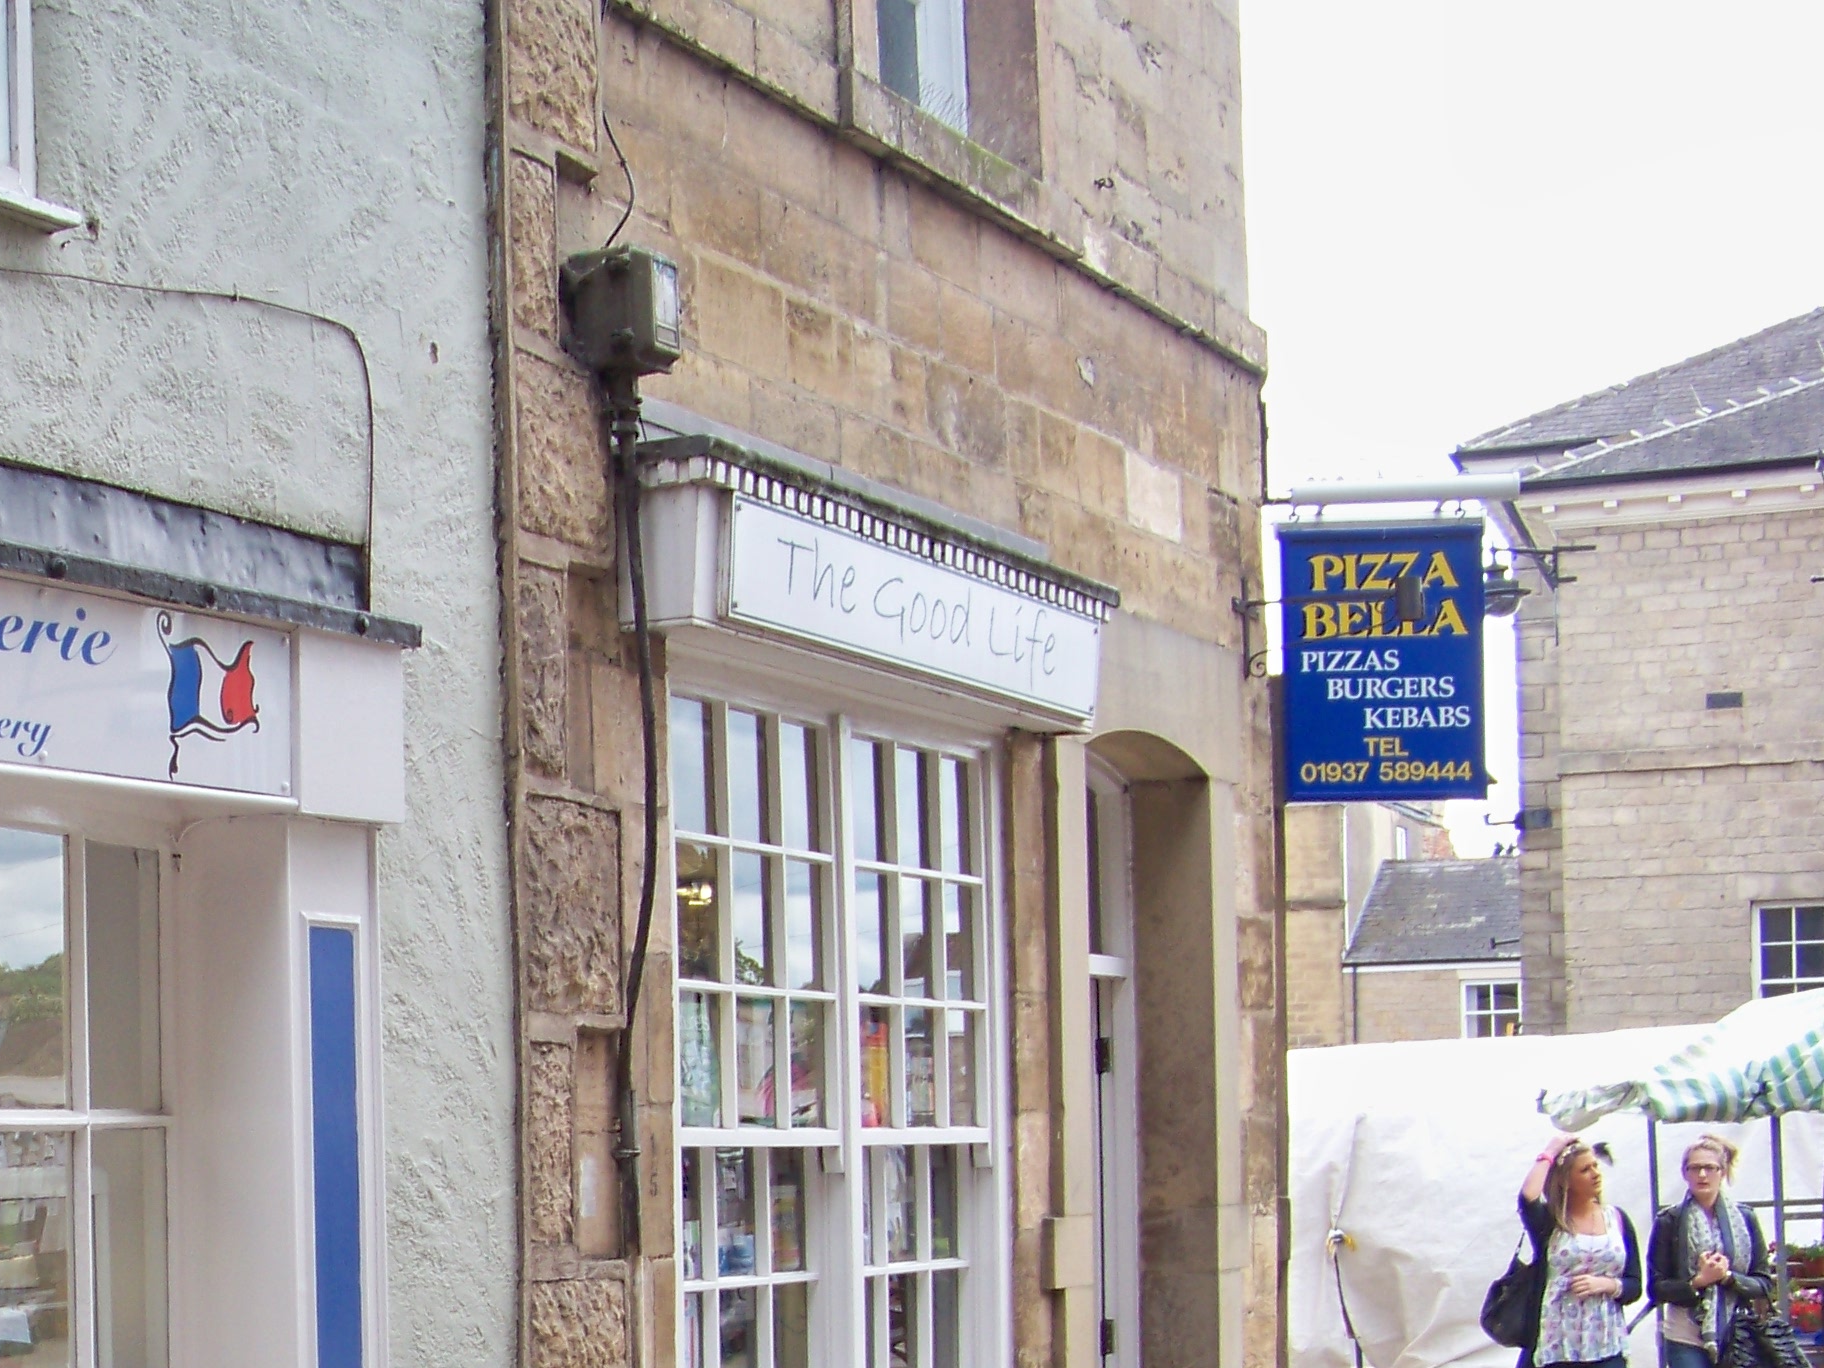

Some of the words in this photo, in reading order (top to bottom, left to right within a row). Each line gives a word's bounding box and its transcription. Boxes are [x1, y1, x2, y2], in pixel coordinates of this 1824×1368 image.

[1307, 551, 1460, 592] PIZZA
[777, 537, 856, 614] The
[874, 577, 970, 644] Good
[989, 605, 1056, 691] Life
[1300, 598, 1469, 640] BELLA
[1300, 649, 1400, 673] PIZZAS
[1327, 676, 1455, 700] BURGERS
[1363, 706, 1471, 730] KEBABS
[1363, 736, 1409, 756] TEL
[1300, 762, 1369, 783] 01937
[1379, 761, 1472, 783] 589444
